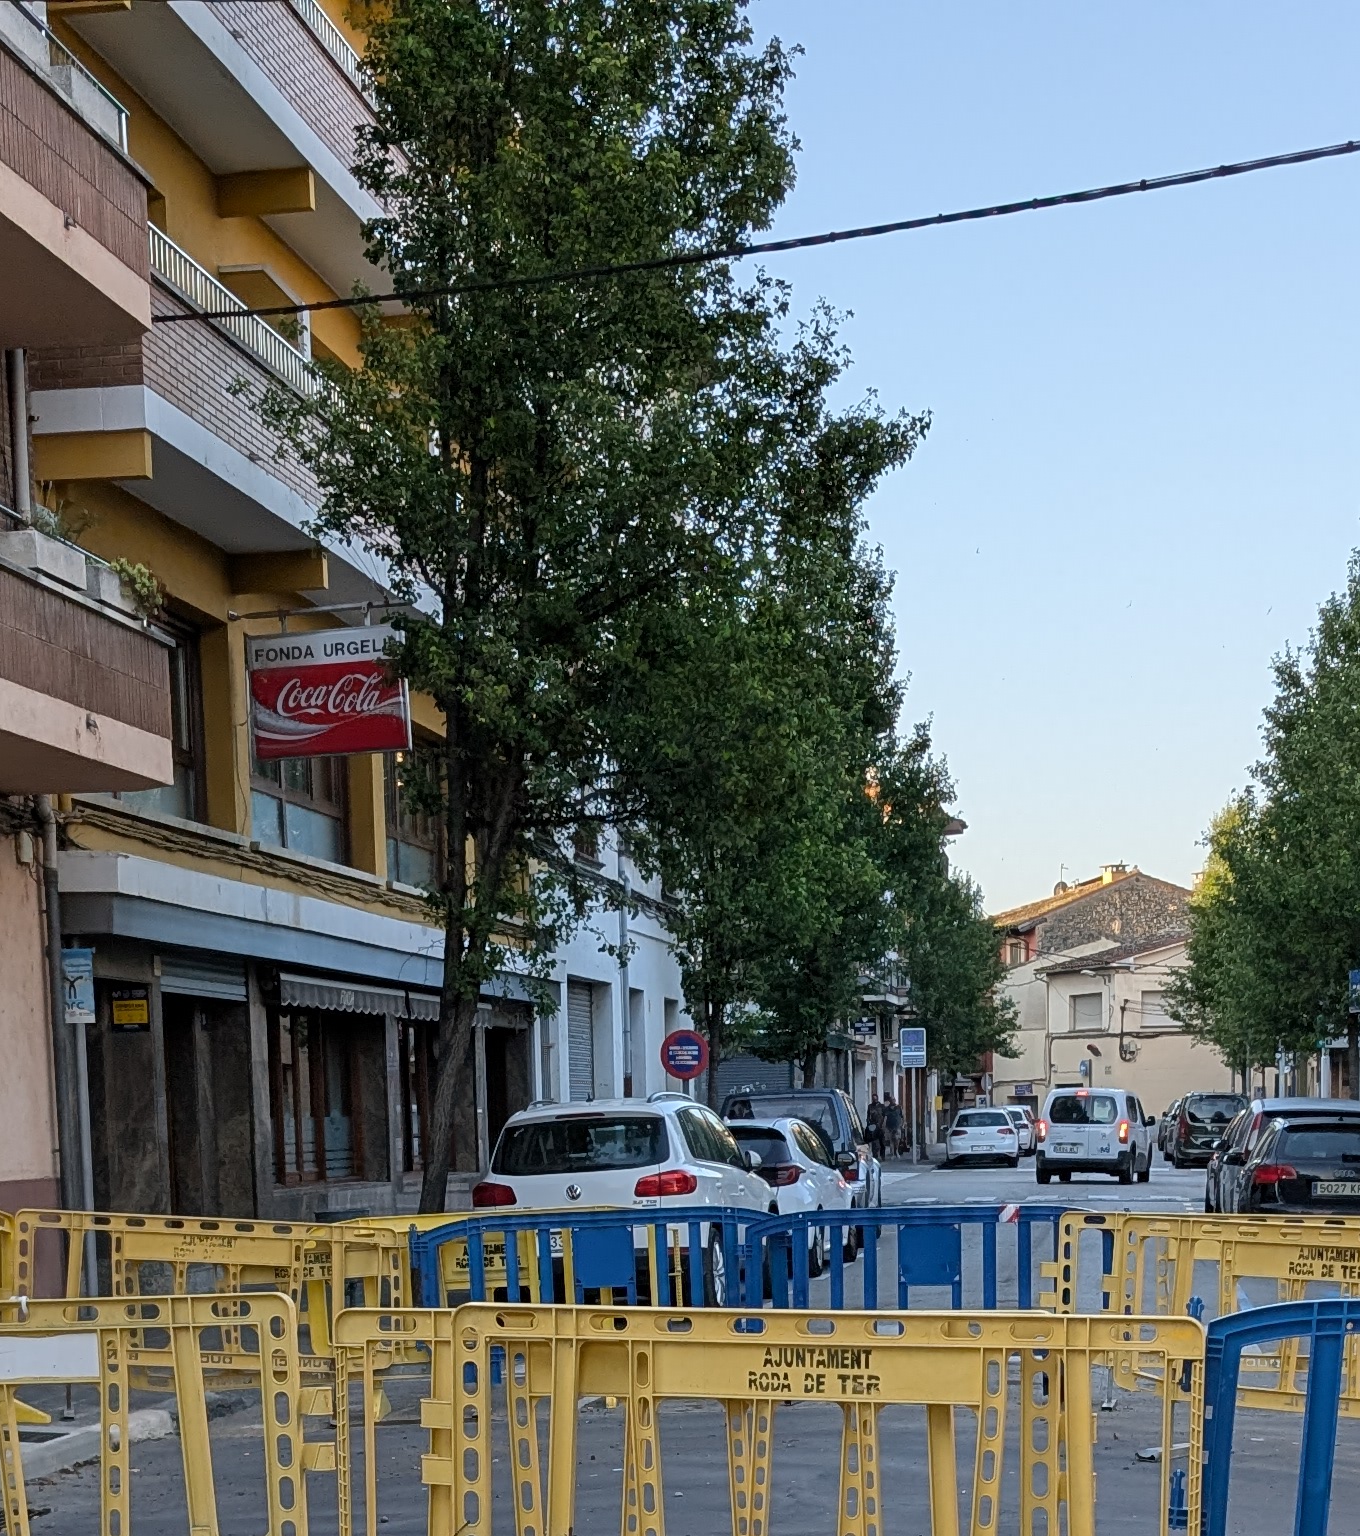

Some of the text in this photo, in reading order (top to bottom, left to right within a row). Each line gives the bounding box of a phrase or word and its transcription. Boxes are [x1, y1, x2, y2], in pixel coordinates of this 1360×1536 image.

[254, 645, 315, 663] FONDA
[1320, 1183, 1347, 1194] 5027
[1288, 1261, 1314, 1277] RODA
[1321, 1263, 1334, 1278] DE
[762, 1346, 873, 1370] AJUNTAMENT
[747, 1370, 881, 1396] RODA DE TER
